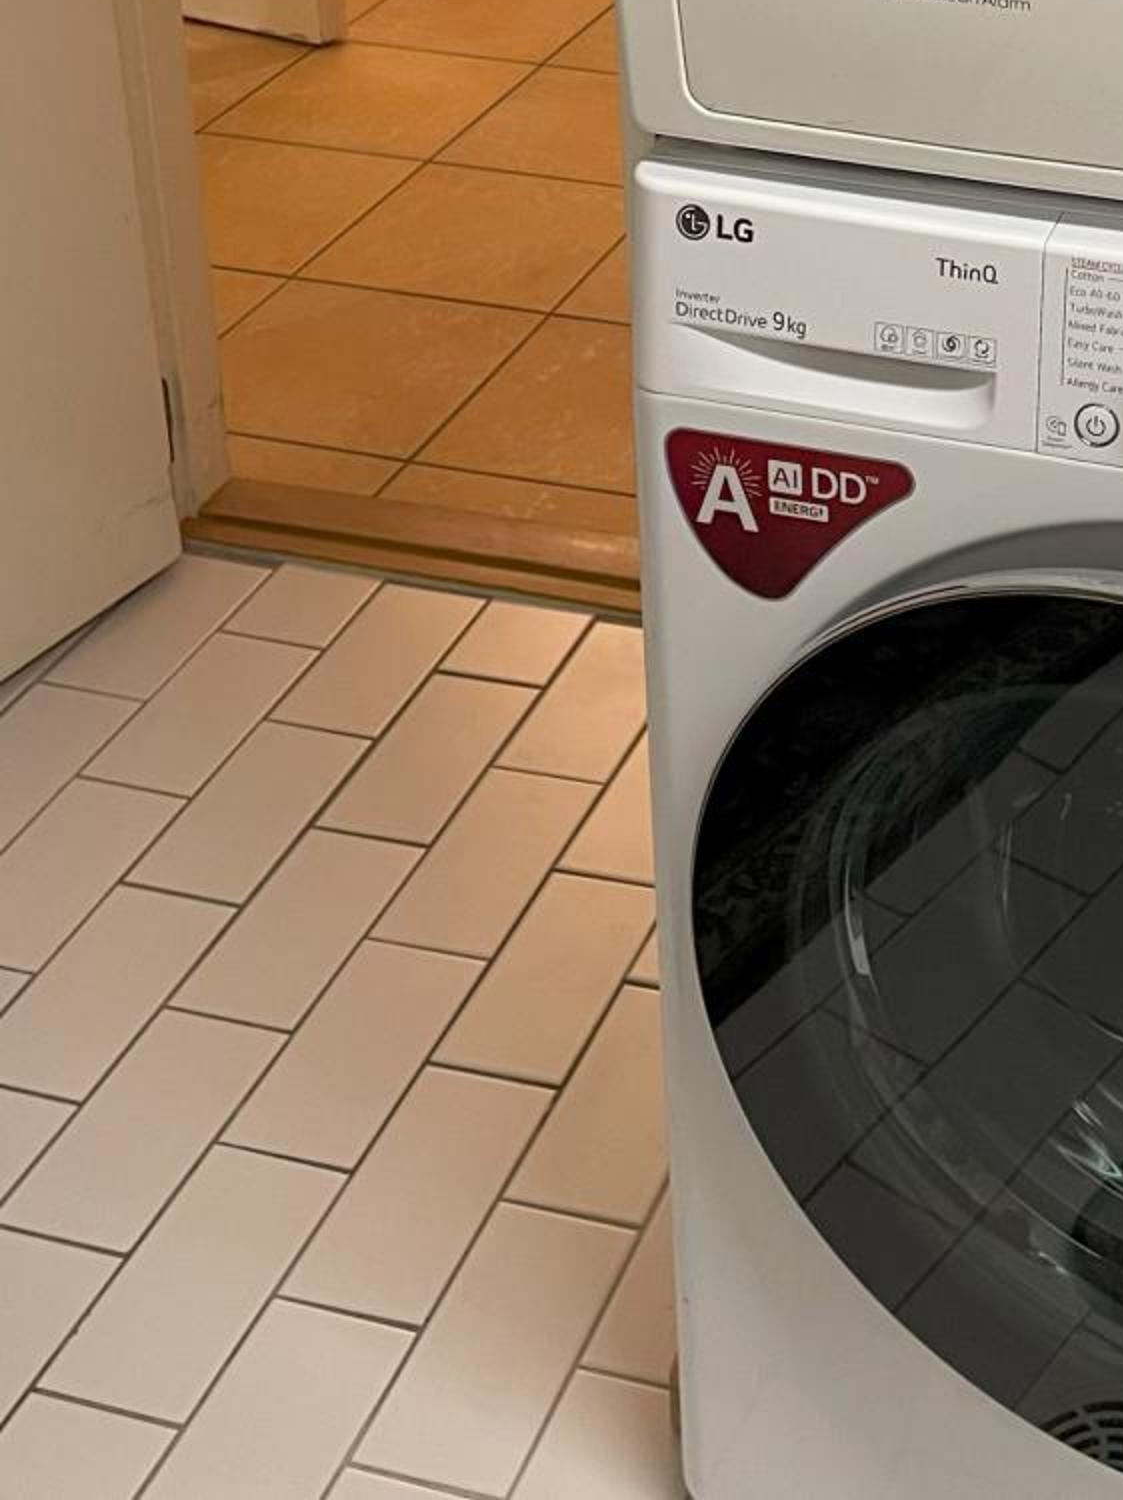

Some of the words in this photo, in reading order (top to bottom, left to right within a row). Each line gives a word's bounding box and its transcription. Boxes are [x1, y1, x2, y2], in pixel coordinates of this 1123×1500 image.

[716, 213, 754, 242] LG
[935, 257, 999, 284] ThinQ
[1071, 270, 1105, 282] Cotton
[675, 288, 720, 303] Inverter
[1070, 286, 1087, 297] Eco
[1068, 320, 1097, 333] Mixed
[1067, 338, 1090, 353] Easy
[1092, 341, 1114, 353] Care
[1067, 357, 1095, 371] Silent
[1097, 360, 1123, 373] Wash
[1066, 378, 1099, 393] Allergy
[1101, 382, 1123, 394] Care
[773, 467, 799, 489] AI
[696, 463, 759, 533] A
